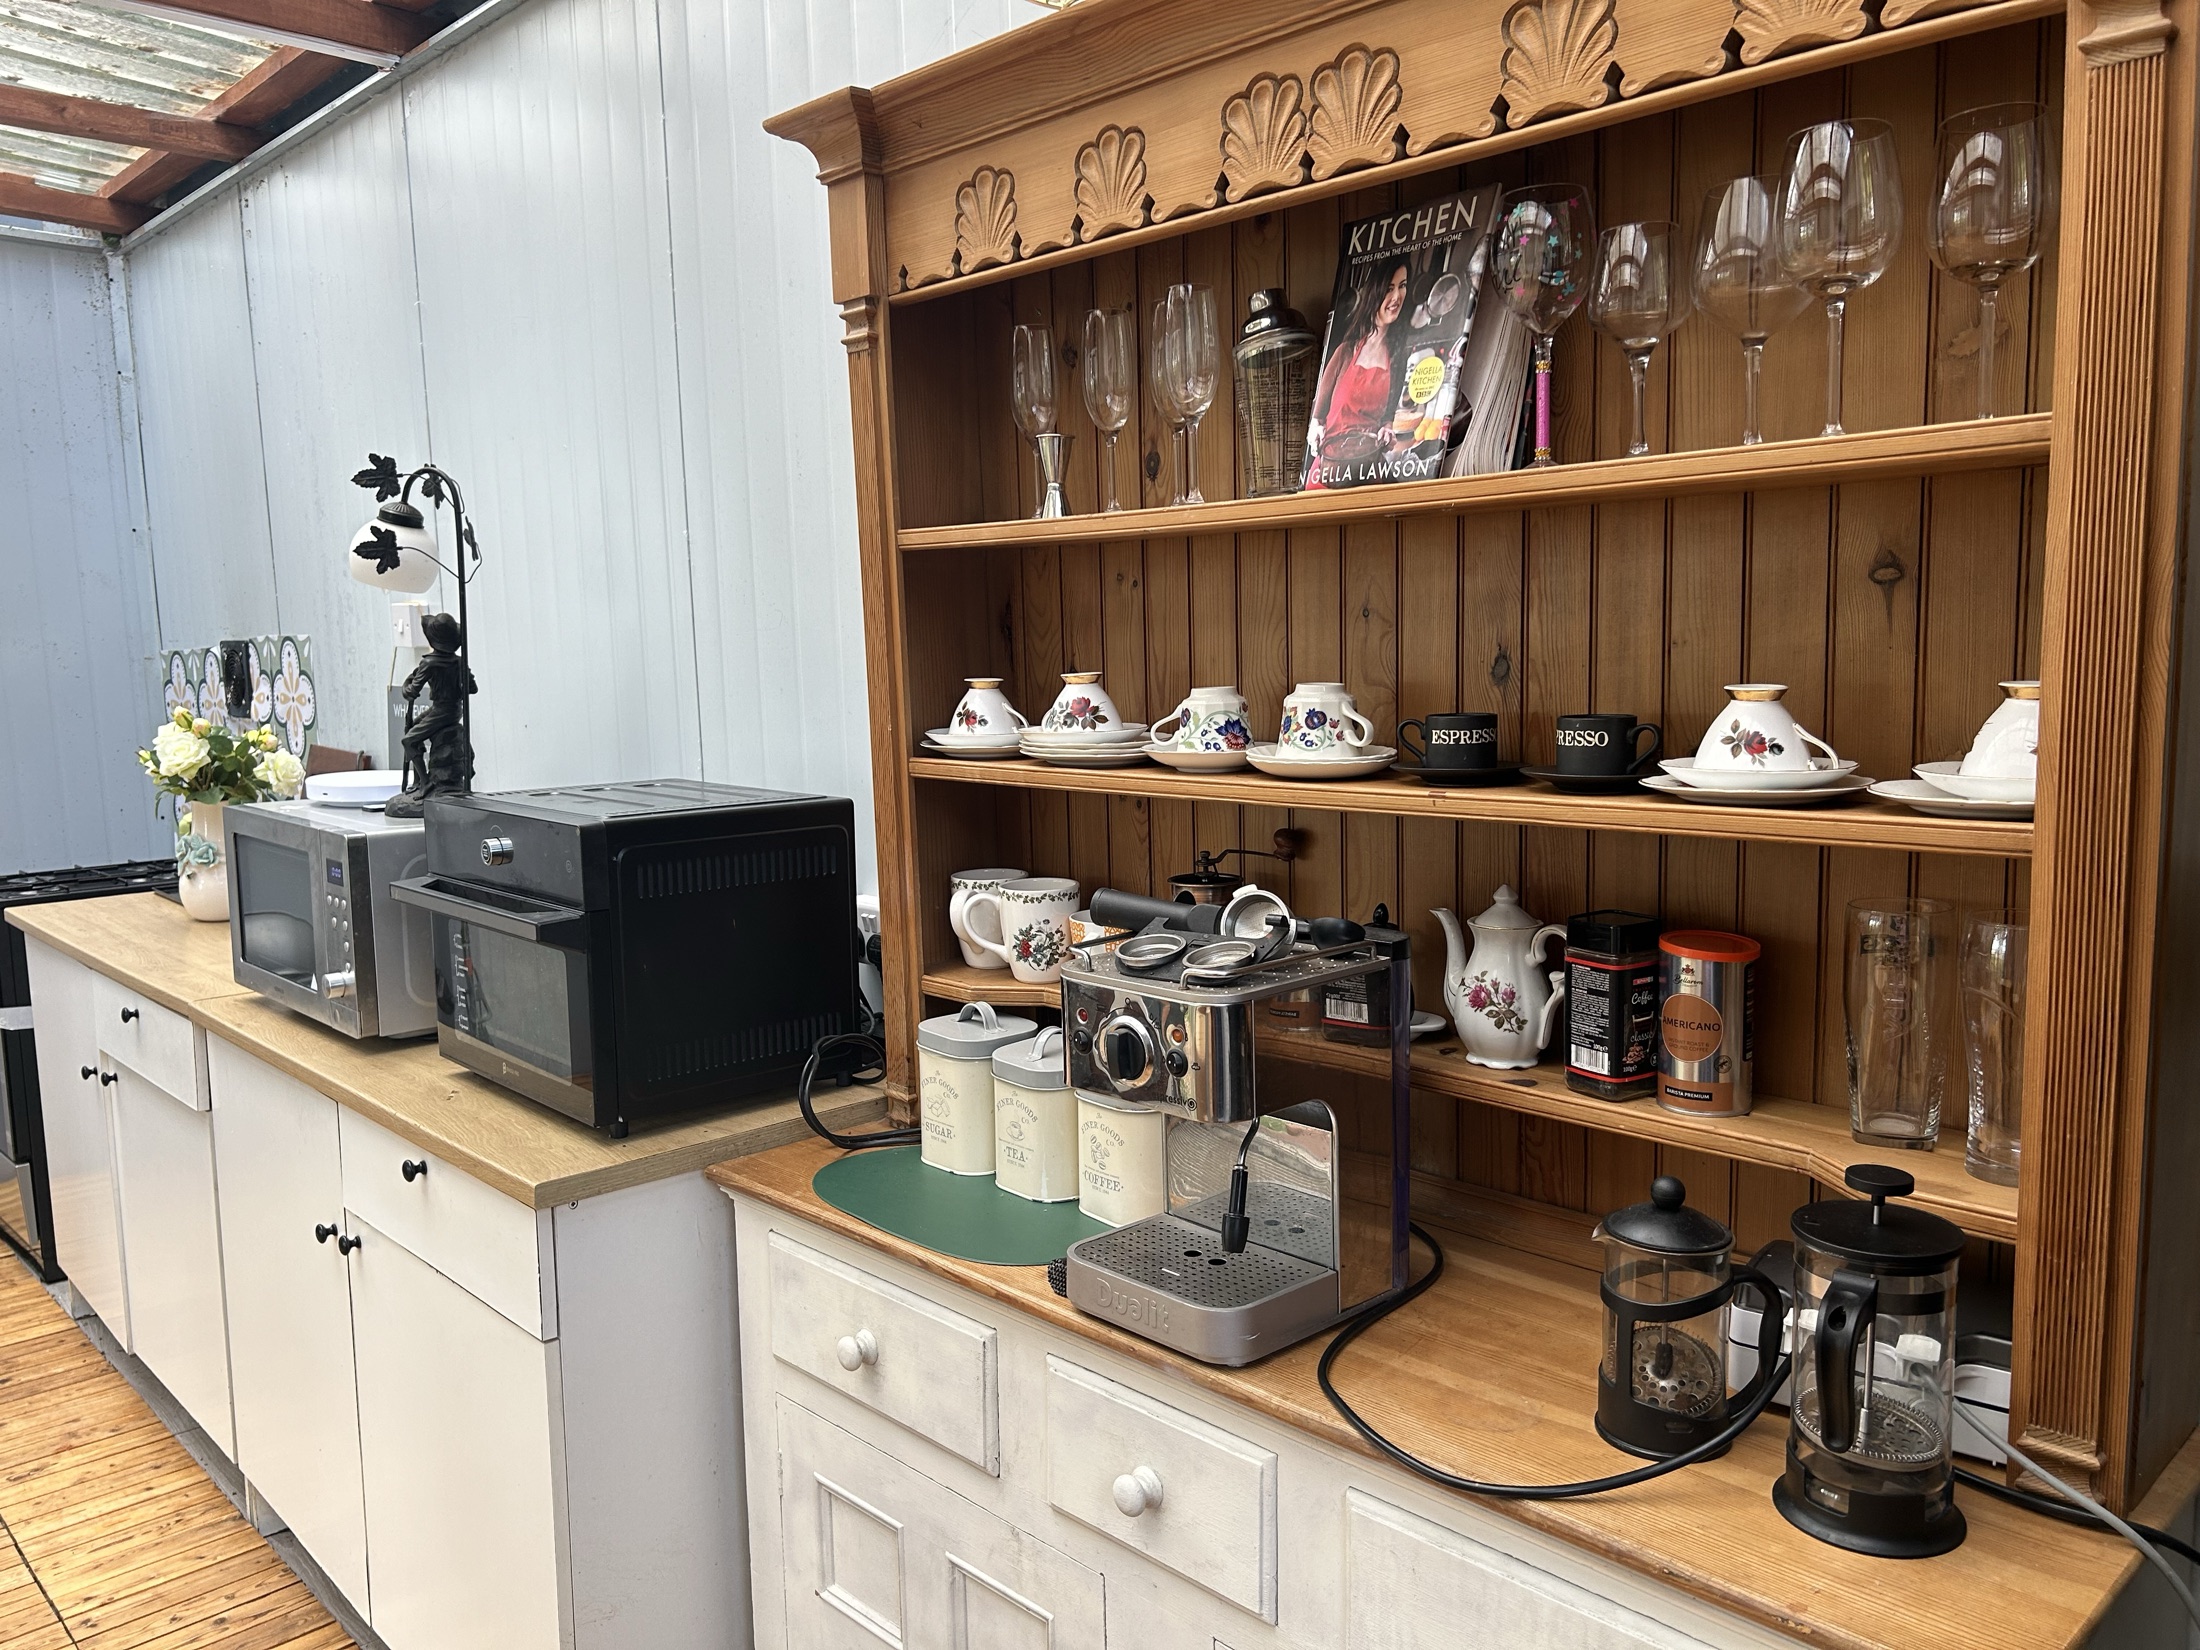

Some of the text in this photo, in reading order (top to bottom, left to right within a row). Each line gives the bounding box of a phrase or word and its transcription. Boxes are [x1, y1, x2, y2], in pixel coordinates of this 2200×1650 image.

[1348, 195, 1478, 255] KITCHEN
[1352, 232, 1462, 265] RECIPES FROM THE HEART OF THE HOME
[1412, 375, 1441, 385] KITCHEN
[1415, 366, 1442, 376] NIGELLA
[1300, 464, 1352, 486] NIGELLA
[1360, 460, 1429, 480] LAWSON
[393, 703, 430, 719] WHEVE
[1431, 728, 1497, 745] ESPRESS
[1663, 1016, 1720, 1032] AMERICANO
[938, 1079, 959, 1100] GOODS
[1684, 1091, 1710, 1099] PREMIUM
[996, 1098, 1038, 1123] FINER GOODS
[925, 1121, 953, 1139] SUGAR
[1081, 1121, 1125, 1146] FINER GOODS
[1005, 1146, 1026, 1163] TEA
[1084, 1170, 1121, 1192] COFFEE
[1097, 1277, 1169, 1334] Dualit
